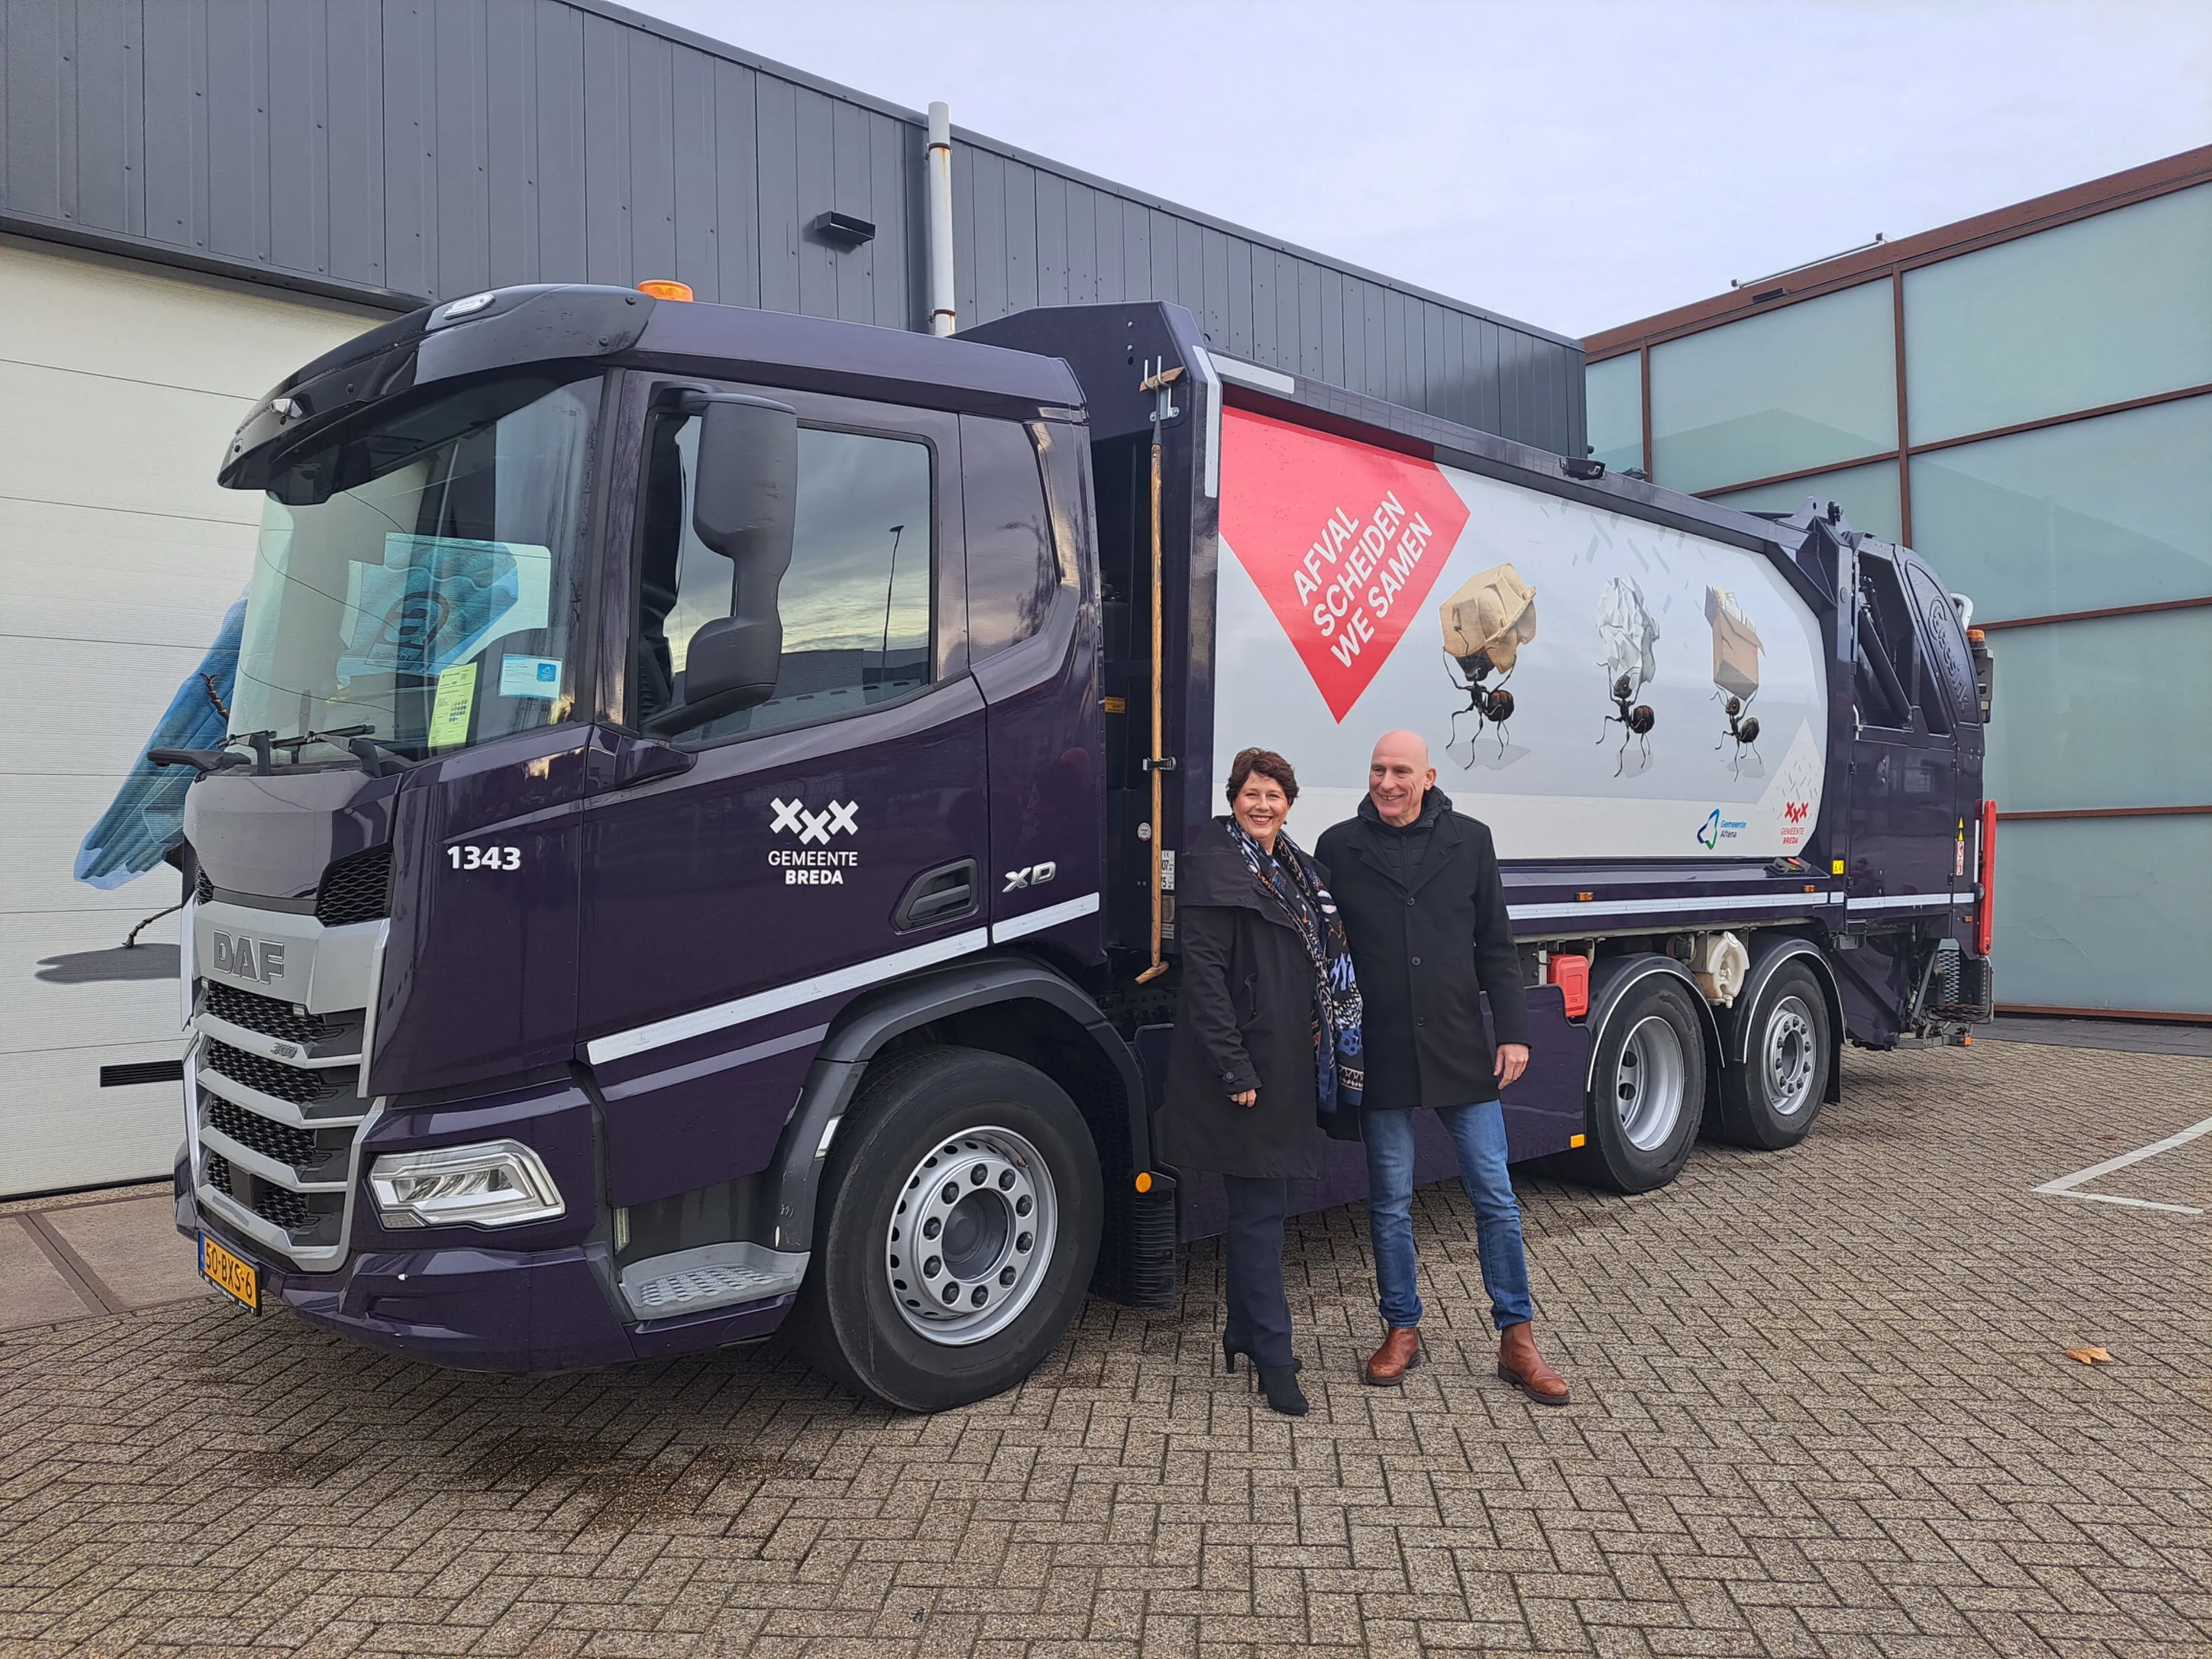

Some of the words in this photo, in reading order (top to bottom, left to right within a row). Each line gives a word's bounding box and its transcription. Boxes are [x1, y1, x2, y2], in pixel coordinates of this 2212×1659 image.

[1293, 506, 1359, 607] AFVAL
[1313, 489, 1406, 637] SCHEIDEN
[1330, 607, 1375, 668] WE
[1368, 511, 1433, 618] SAMEN
[1719, 829, 1738, 838] Altena
[1720, 819, 1747, 829] Gemeente
[1780, 827, 1806, 835] GEMEENTE
[447, 846, 521, 870] 1343
[768, 851, 857, 866] GEMEENTE
[785, 870, 843, 885] BREDA
[1002, 861, 1056, 894] XD
[212, 929, 286, 984] DAF
[205, 1242, 253, 1300] 50-BXS-6
